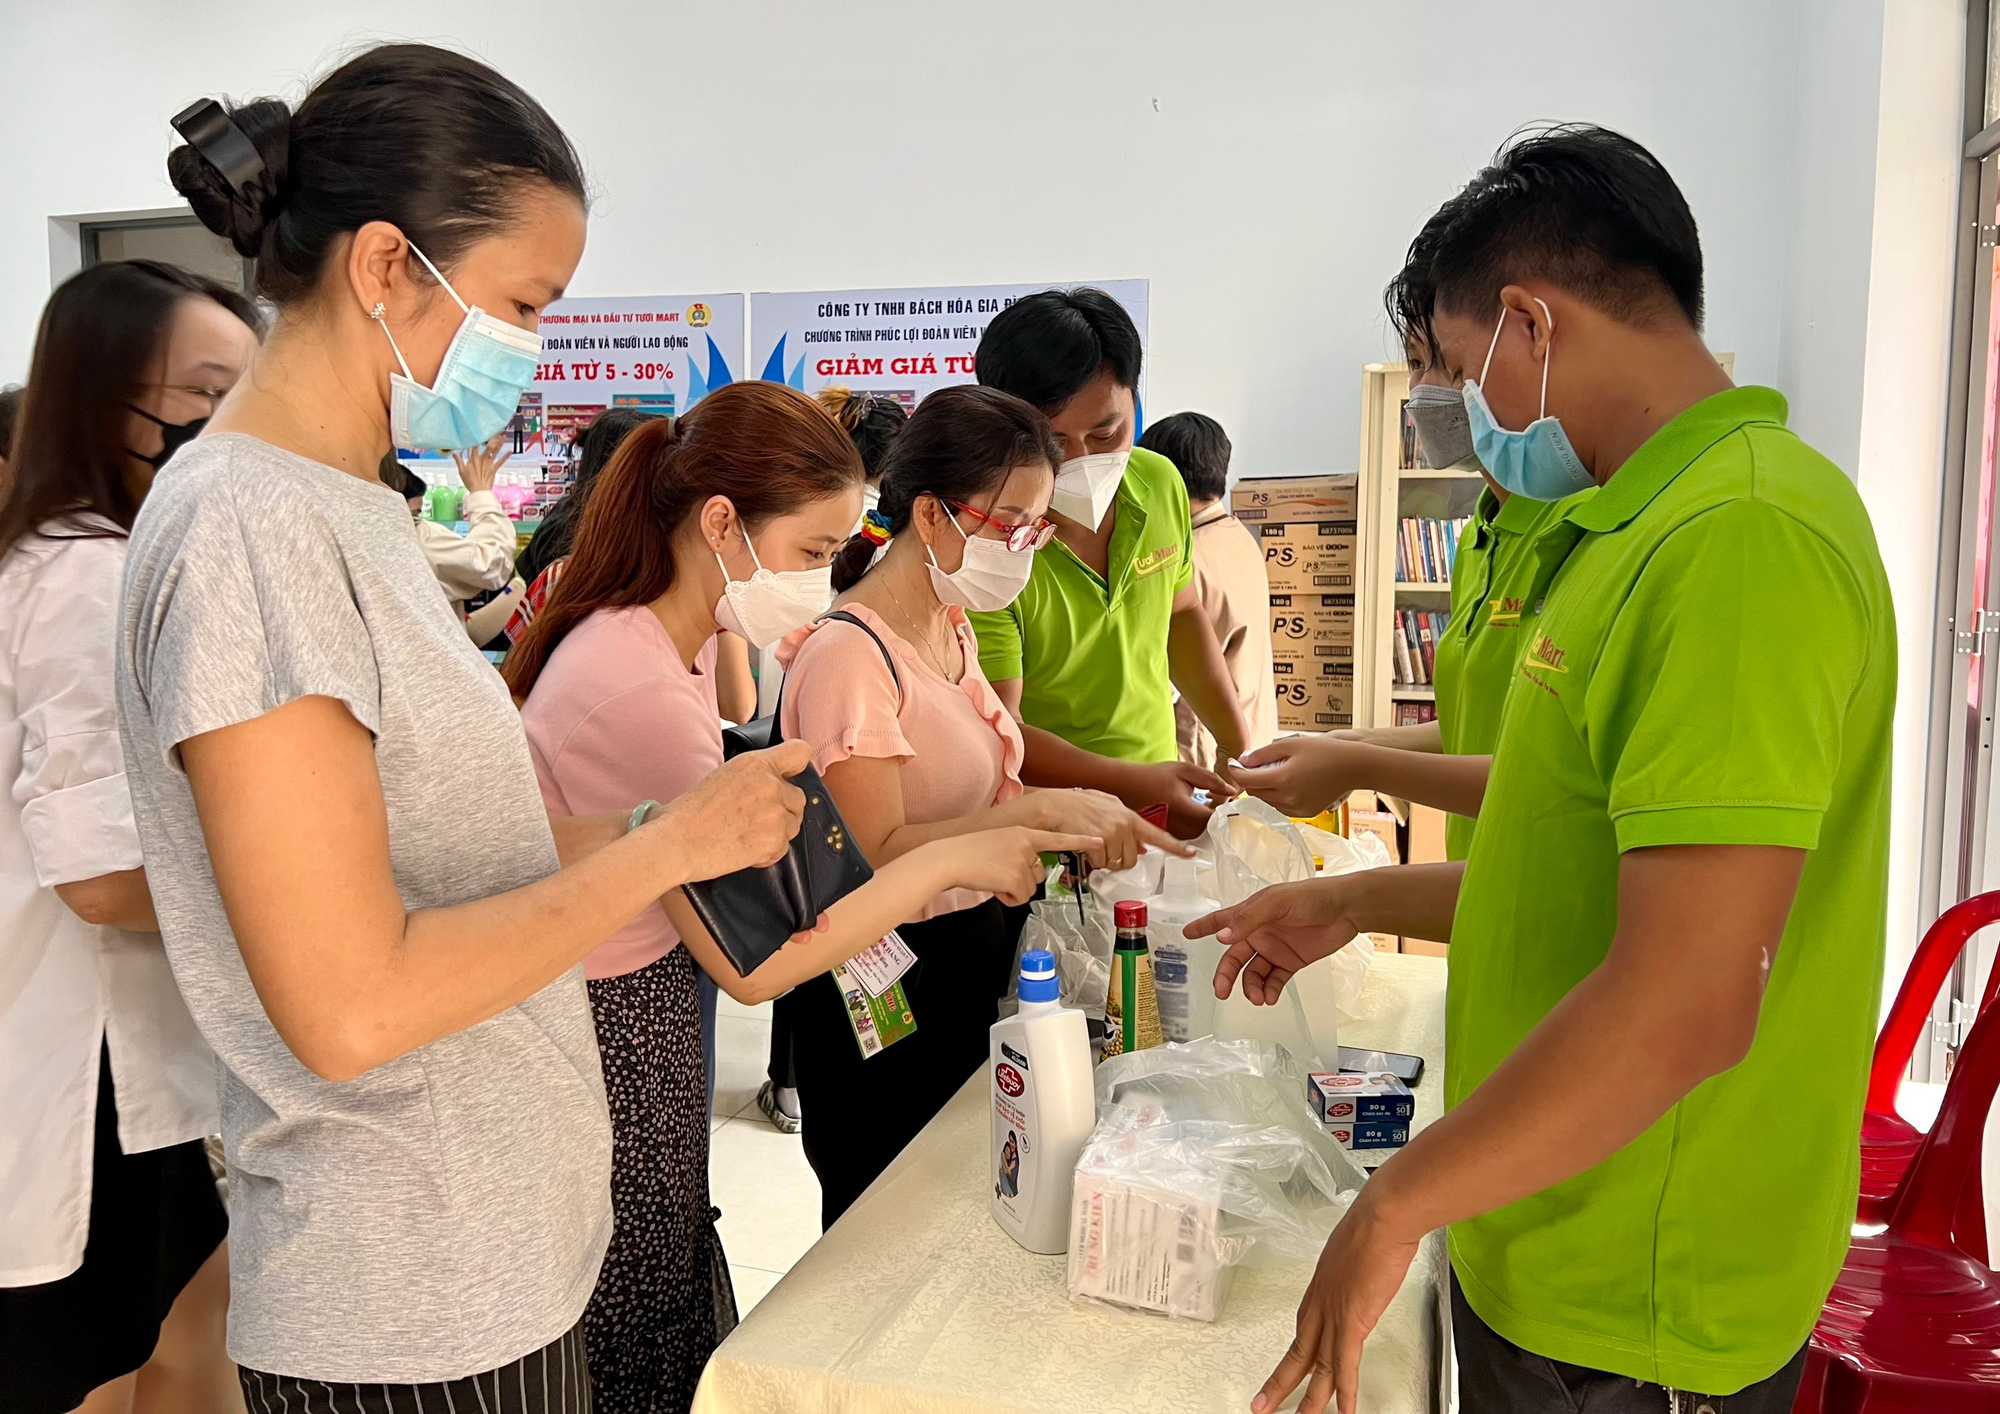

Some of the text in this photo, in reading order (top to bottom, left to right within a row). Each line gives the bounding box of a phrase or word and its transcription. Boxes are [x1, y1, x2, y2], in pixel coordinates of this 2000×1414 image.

[818, 302, 850, 318] CÔNG
[855, 303, 869, 316] TY
[875, 302, 905, 316] TNHH
[910, 298, 942, 315] BÁCH
[947, 297, 973, 314] HÓA
[978, 299, 999, 313] GIA
[573, 315, 588, 326] MẠI
[591, 312, 602, 323] VÀ
[623, 313, 635, 322] TƯ
[635, 313, 653, 322] TƯƠI
[656, 313, 680, 323] MART
[548, 336, 571, 350] ĐOÀN
[575, 335, 595, 350] VIÊN
[598, 335, 610, 349] VÀ
[613, 335, 640, 349] NGƯỜI
[643, 337, 660, 349] LAO
[664, 336, 689, 351] ĐỘNG
[805, 330, 842, 343] CHƯƠNG
[845, 328, 872, 342] TRÌNH
[875, 326, 900, 341] PHÚC
[904, 327, 919, 344] LỢI
[922, 326, 950, 341] ĐOÀN
[953, 325, 977, 340] VIÊN
[571, 358, 601, 381] TỪ
[606, 364, 616, 380] 5
[634, 363, 674, 380] 30%
[816, 353, 883, 376] GIẢM
[890, 353, 937, 375] GIÁ
